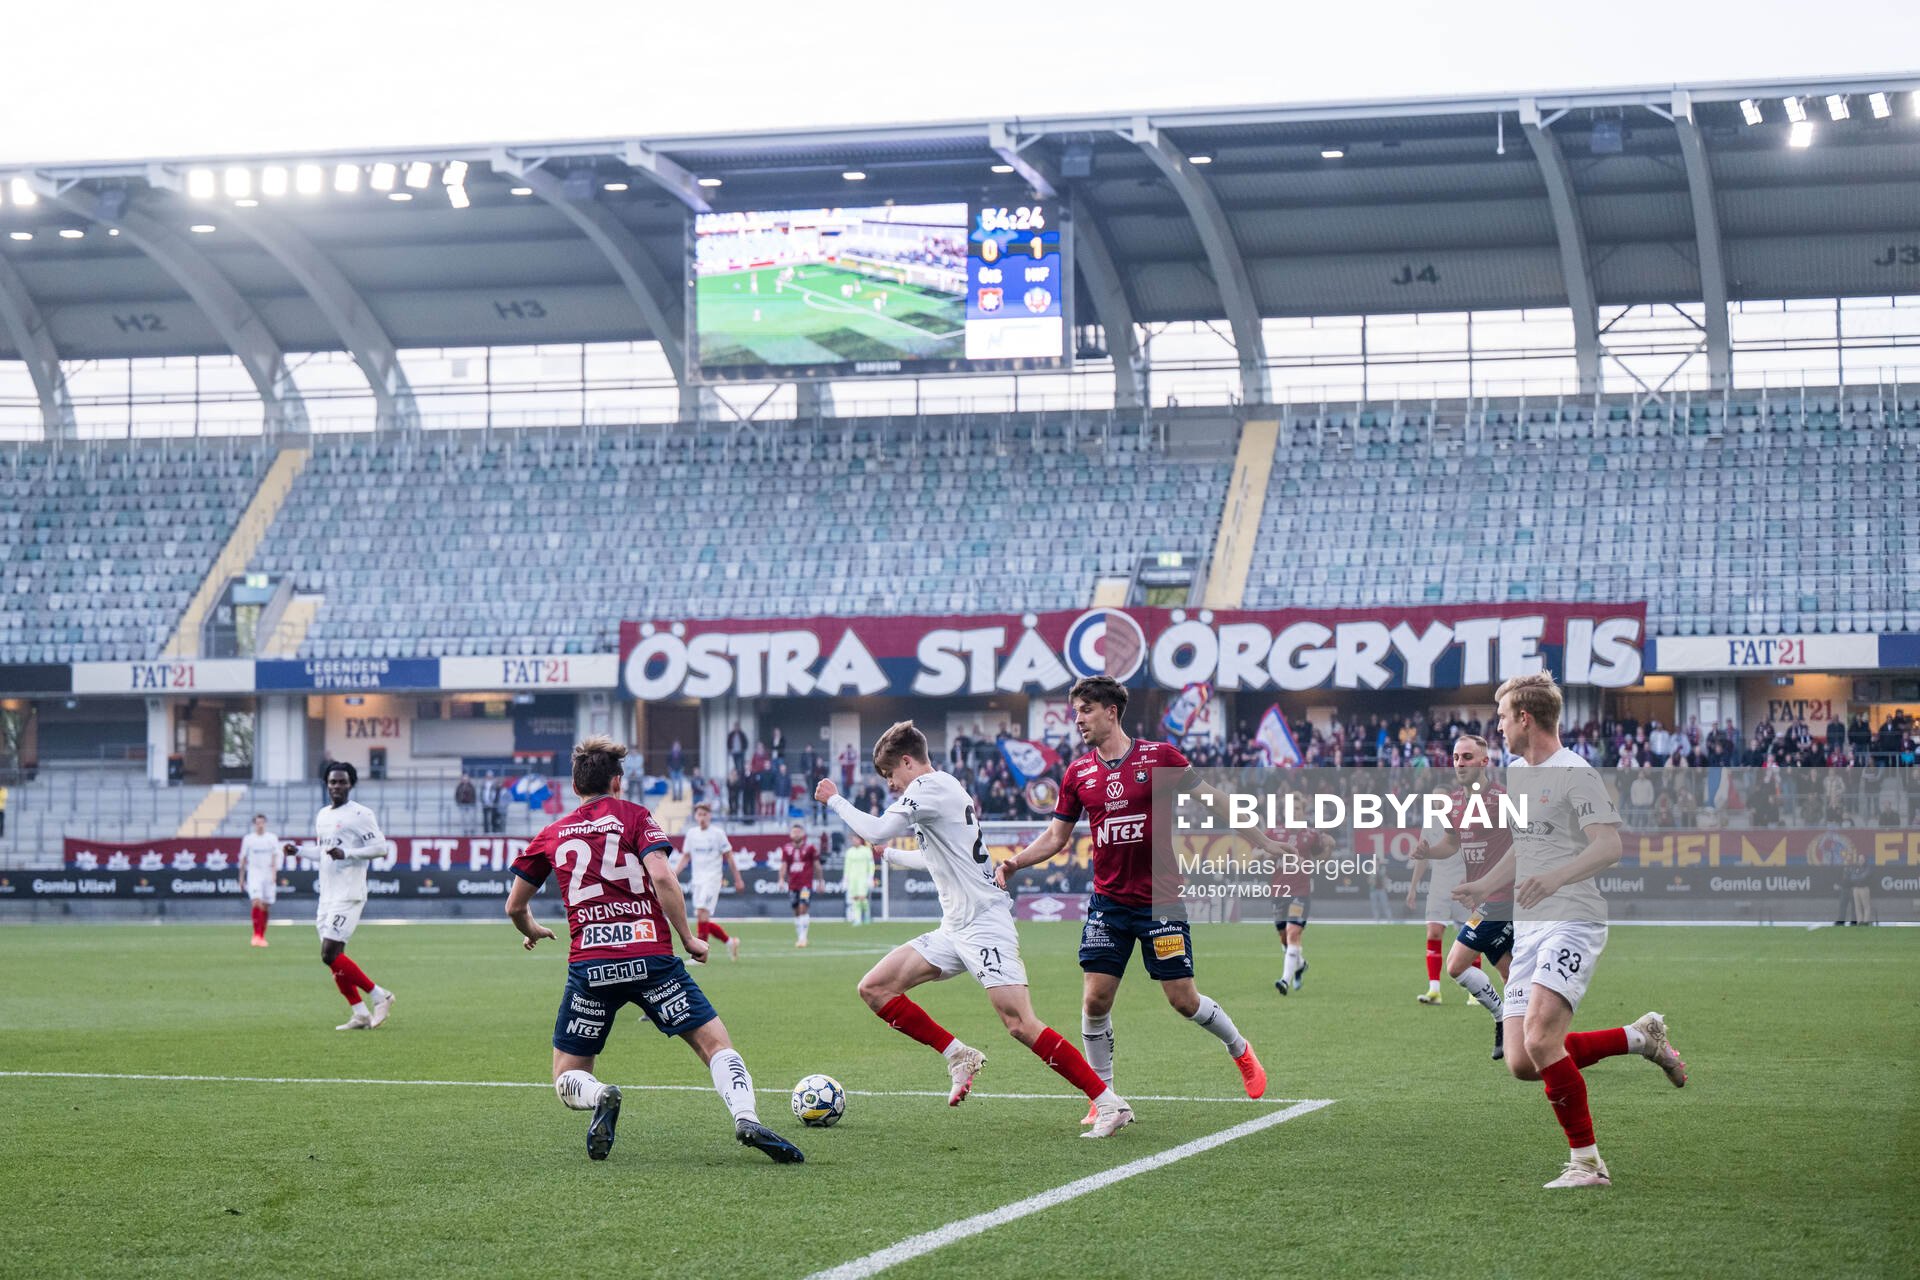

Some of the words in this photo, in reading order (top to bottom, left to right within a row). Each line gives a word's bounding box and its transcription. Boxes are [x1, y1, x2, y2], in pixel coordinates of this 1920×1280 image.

[982, 239, 998, 262] 0
[1030, 236, 1043, 259] 1
[1391, 264, 1440, 285] J4
[624, 621, 891, 701] ÖSTRA
[912, 612, 1073, 696] STÅ
[1153, 608, 1547, 690] ÖRGRYTE
[1564, 616, 1643, 688] IS
[1727, 638, 1807, 665] FAT21
[131, 664, 196, 688] FAT21
[502, 659, 569, 683] FAT21
[1768, 699, 1834, 722] FAT21
[344, 717, 401, 739] FAT21
[1097, 814, 1147, 848] NTEX
[555, 832, 646, 907] 24
[32, 878, 77, 893] Gamla
[171, 878, 216, 893] Gamla
[1710, 876, 1762, 891] Gamla
[1765, 876, 1811, 891] Ullevi
[333, 914, 347, 928] 27
[577, 901, 653, 924] SVENSSON
[584, 925, 634, 946] BESAB
[980, 946, 1002, 967] 21
[1557, 948, 1582, 973] 23
[658, 991, 691, 1024] NTEX
[566, 1017, 606, 1038] NTEX
